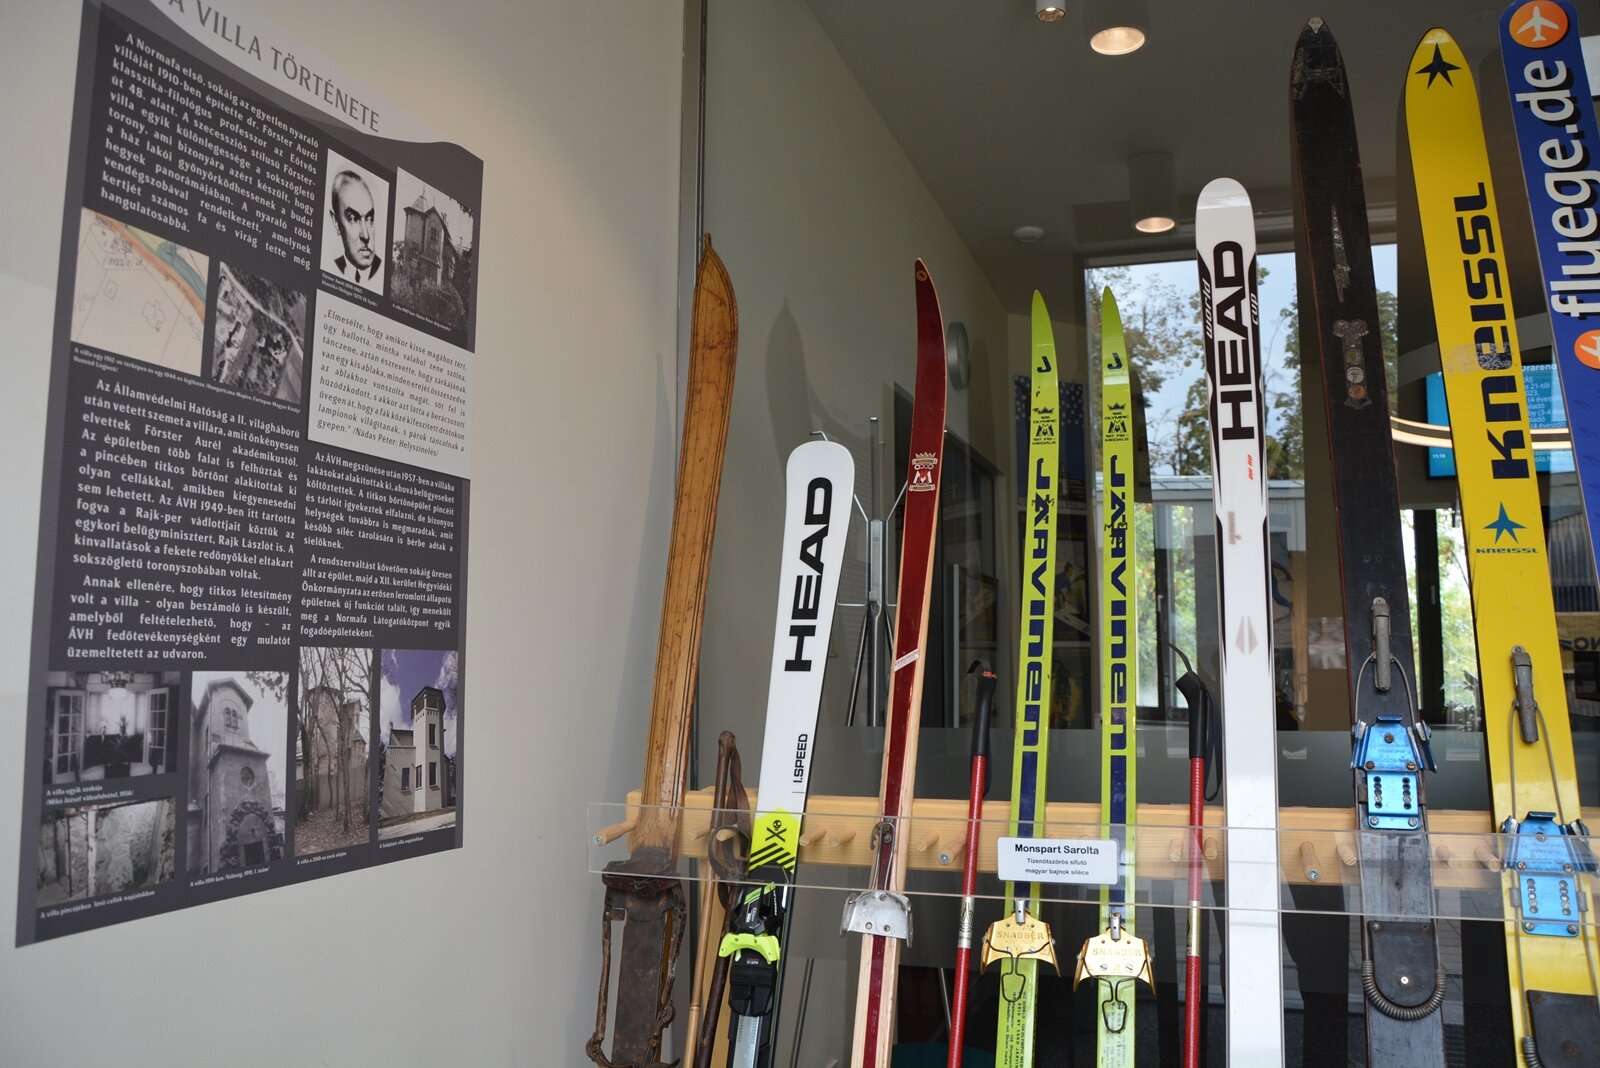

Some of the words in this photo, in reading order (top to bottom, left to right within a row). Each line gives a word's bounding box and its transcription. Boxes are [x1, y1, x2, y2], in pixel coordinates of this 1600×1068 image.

[126, 32, 133, 44] A
[136, 37, 180, 71] Normafa
[207, 80, 237, 105] sokáig
[239, 99, 249, 109] az
[250, 105, 287, 131] egyetlen
[289, 127, 318, 148] nyaraló
[194, 0, 262, 62] VILLA
[270, 46, 380, 132] TÖRTÉNETE
[111, 76, 123, 88] út
[128, 83, 145, 100] 48.
[150, 97, 177, 116] alatt.
[182, 111, 188, 122] A
[193, 119, 247, 152] szecessziós
[251, 149, 280, 169] stílusú
[112, 57, 212, 118] klasszika-filológus
[219, 118, 267, 147] professzor
[273, 146, 283, 156] az
[290, 153, 316, 174] Eötvös
[114, 44, 152, 71] villáját
[157, 66, 201, 98] 1910-ben
[205, 94, 243, 120] építette
[246, 116, 258, 129] dr.
[262, 124, 292, 147] Förster
[296, 143, 317, 161] Aurél
[100, 186, 189, 232] hangulatosabbá.
[105, 137, 145, 165] hegyek
[155, 163, 233, 205] panorámájában.
[241, 201, 247, 211] A
[255, 210, 287, 229] nyaraló
[294, 226, 312, 240] több
[1515, 59, 1600, 319] fluege.de
[1202, 278, 1213, 340] world
[1250, 292, 1259, 326] cup
[1036, 356, 1052, 373] J
[1106, 352, 1122, 369] J
[1214, 240, 1254, 440] HEAD
[96, 378, 110, 391] Az
[113, 381, 186, 410] Államvédelmi
[188, 401, 227, 423] Hatóság
[229, 414, 234, 422] a
[237, 414, 246, 425] II.
[248, 418, 299, 438] világháború
[81, 428, 95, 440] Az
[103, 433, 160, 453] épületben
[167, 447, 190, 459] több
[197, 451, 219, 465] falat
[226, 457, 234, 468] is
[240, 460, 282, 478] felhúztak
[288, 471, 297, 481] és
[82, 411, 130, 430] elvettek
[144, 424, 182, 441] Förster
[194, 435, 221, 450] Aurél
[232, 444, 298, 466] akadémikustól.
[79, 448, 86, 456] a
[94, 449, 146, 467] pincében
[154, 460, 184, 474] titkos
[191, 466, 228, 482] börtönt
[234, 475, 282, 492] alakítottak
[288, 485, 296, 495] ki
[77, 482, 101, 494] sem
[106, 484, 154, 502] lehetett.
[158, 494, 171, 505] Az
[175, 494, 196, 509] ÁVH
[200, 500, 244, 516] 1949-ben
[247, 508, 258, 518] itt
[262, 511, 295, 524] tartotta
[75, 518, 119, 532] egykori
[218, 534, 238, 547] Rajk
[241, 537, 273, 550] Lászlót
[275, 542, 285, 552] is.
[288, 544, 294, 553] A
[784, 477, 832, 672] HEAD
[66, 646, 143, 658] üzemeltetett
[146, 650, 158, 658] az
[162, 648, 206, 658] udvaron.
[68, 626, 93, 639] ÁVH
[106, 628, 220, 645] fedőtevékenységként
[230, 635, 247, 647] egy
[257, 635, 290, 645] mulatót
[793, 733, 808, 783] I.SPEED
[1015, 844, 1061, 855] Monspart
[1064, 845, 1100, 855] Sarolta
[996, 930, 1044, 940] SNABBER
